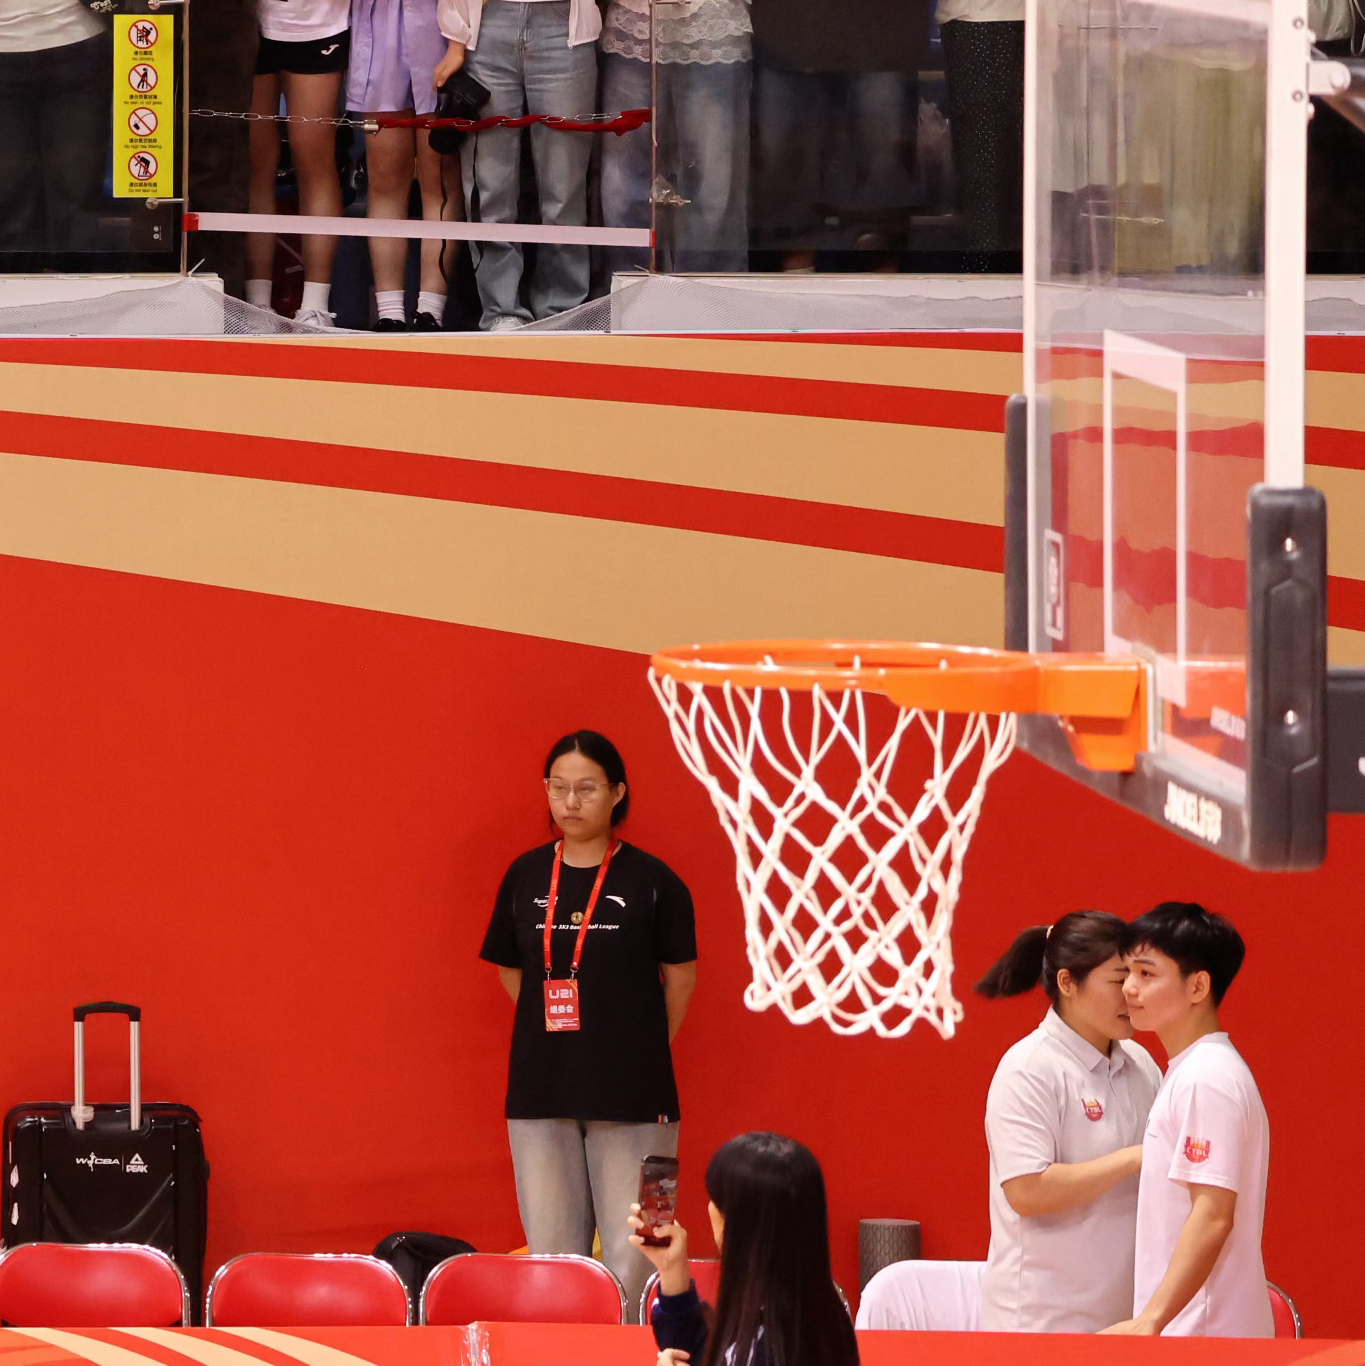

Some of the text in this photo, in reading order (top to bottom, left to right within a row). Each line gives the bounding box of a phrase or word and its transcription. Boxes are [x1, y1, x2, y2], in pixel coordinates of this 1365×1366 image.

[599, 923, 620, 931] League
[549, 988, 573, 1000] U21
[549, 1004, 574, 1014] 组委会
[126, 1165, 148, 1173] PEAK
